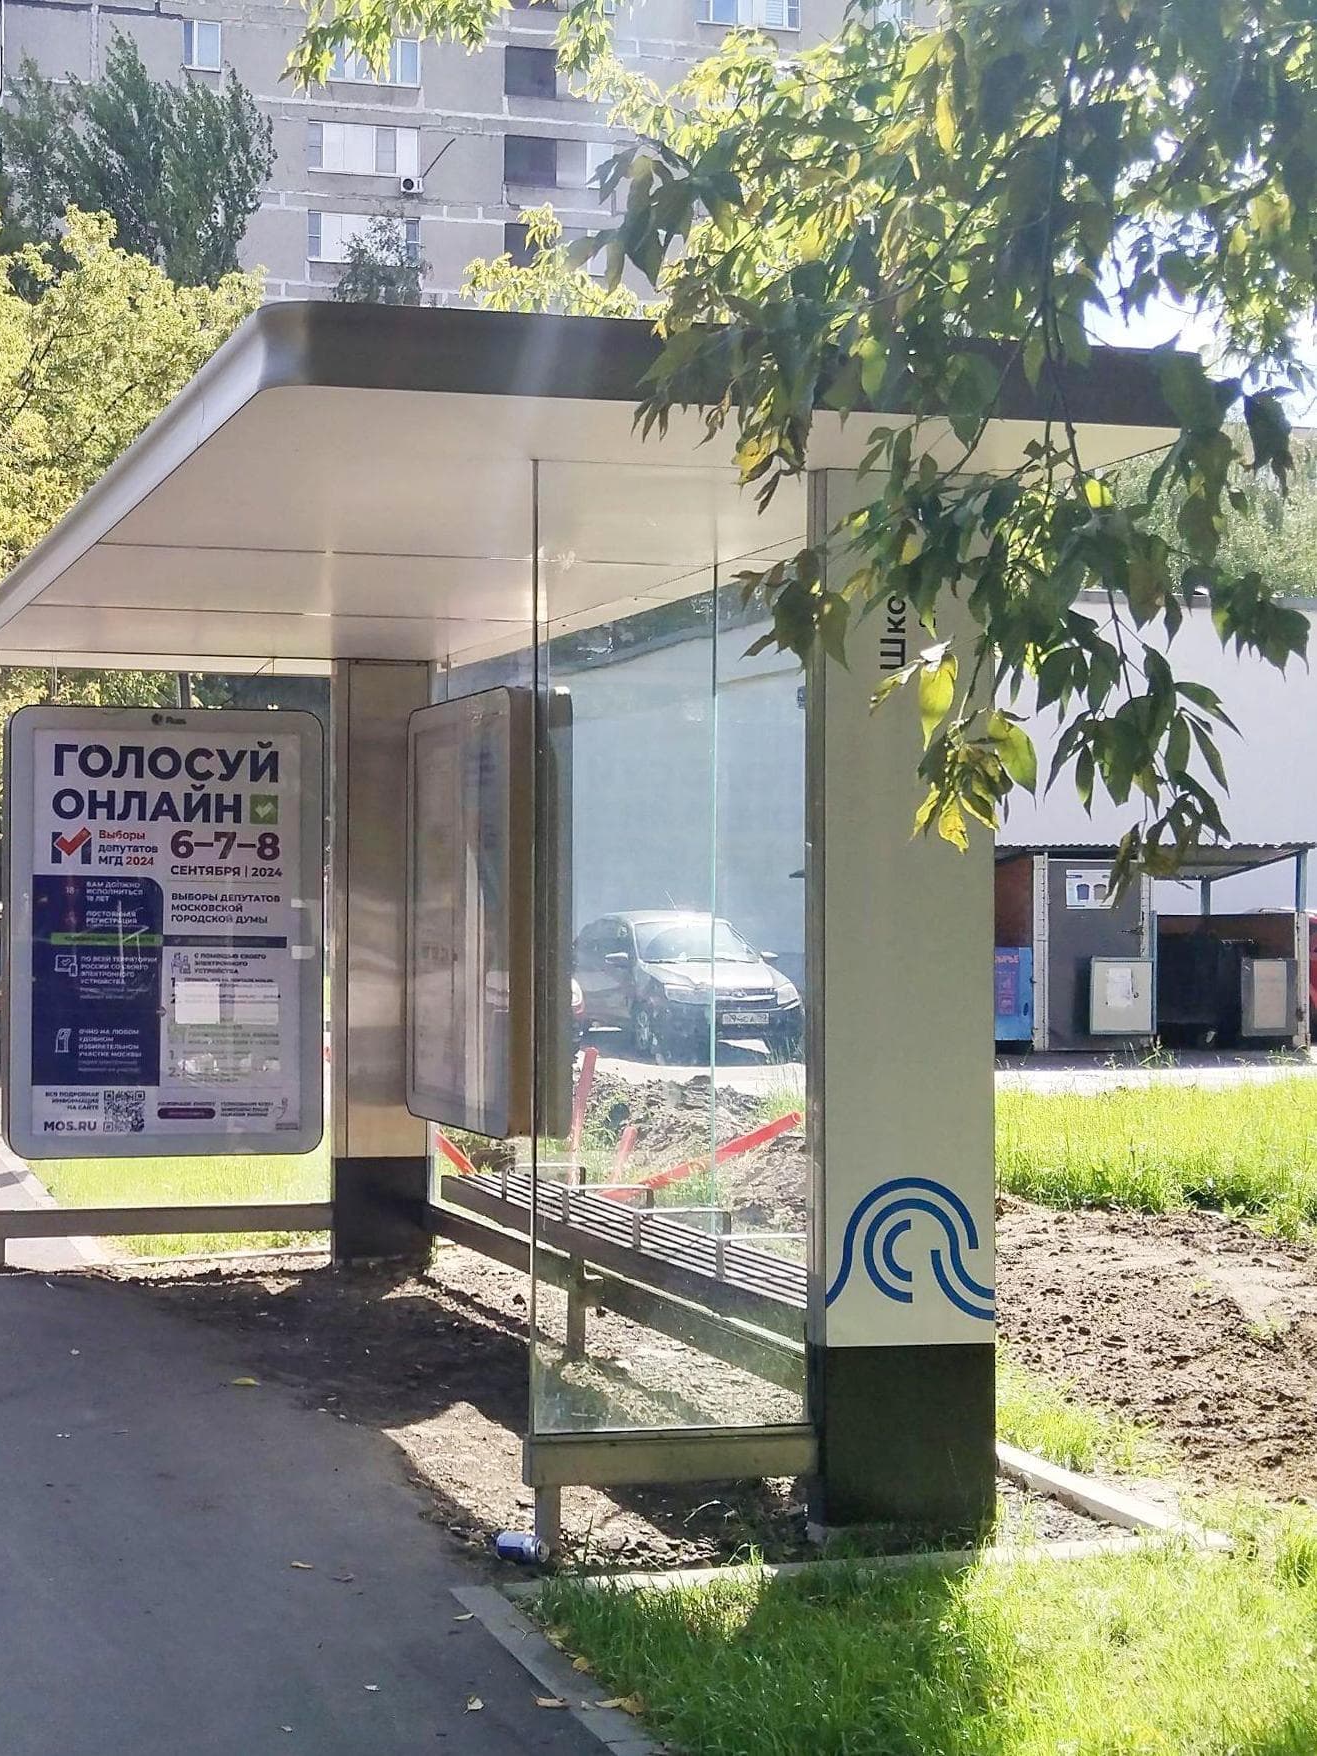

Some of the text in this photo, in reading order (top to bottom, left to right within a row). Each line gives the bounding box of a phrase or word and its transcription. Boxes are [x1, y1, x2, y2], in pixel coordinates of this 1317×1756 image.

[880, 595, 906, 670] Шко
[53, 740, 280, 783] ГОЛОСУЙ
[52, 783, 242, 824] ОНЛАЙН
[98, 830, 146, 842] Выборы
[98, 843, 159, 855] депутатов
[170, 829, 281, 861] 6–7–8
[98, 855, 155, 867] МГД 2024
[170, 865, 284, 878] СЕНТЯБРЯ 2024
[171, 892, 281, 903] ВЫБОРЫ ДЕПУТАТОВ
[171, 903, 243, 913] МОСКОВСКОЙ
[170, 914, 268, 924] ГОРОДСКОЙ ДУМЫ
[43, 1121, 97, 1132] MOS.RU
